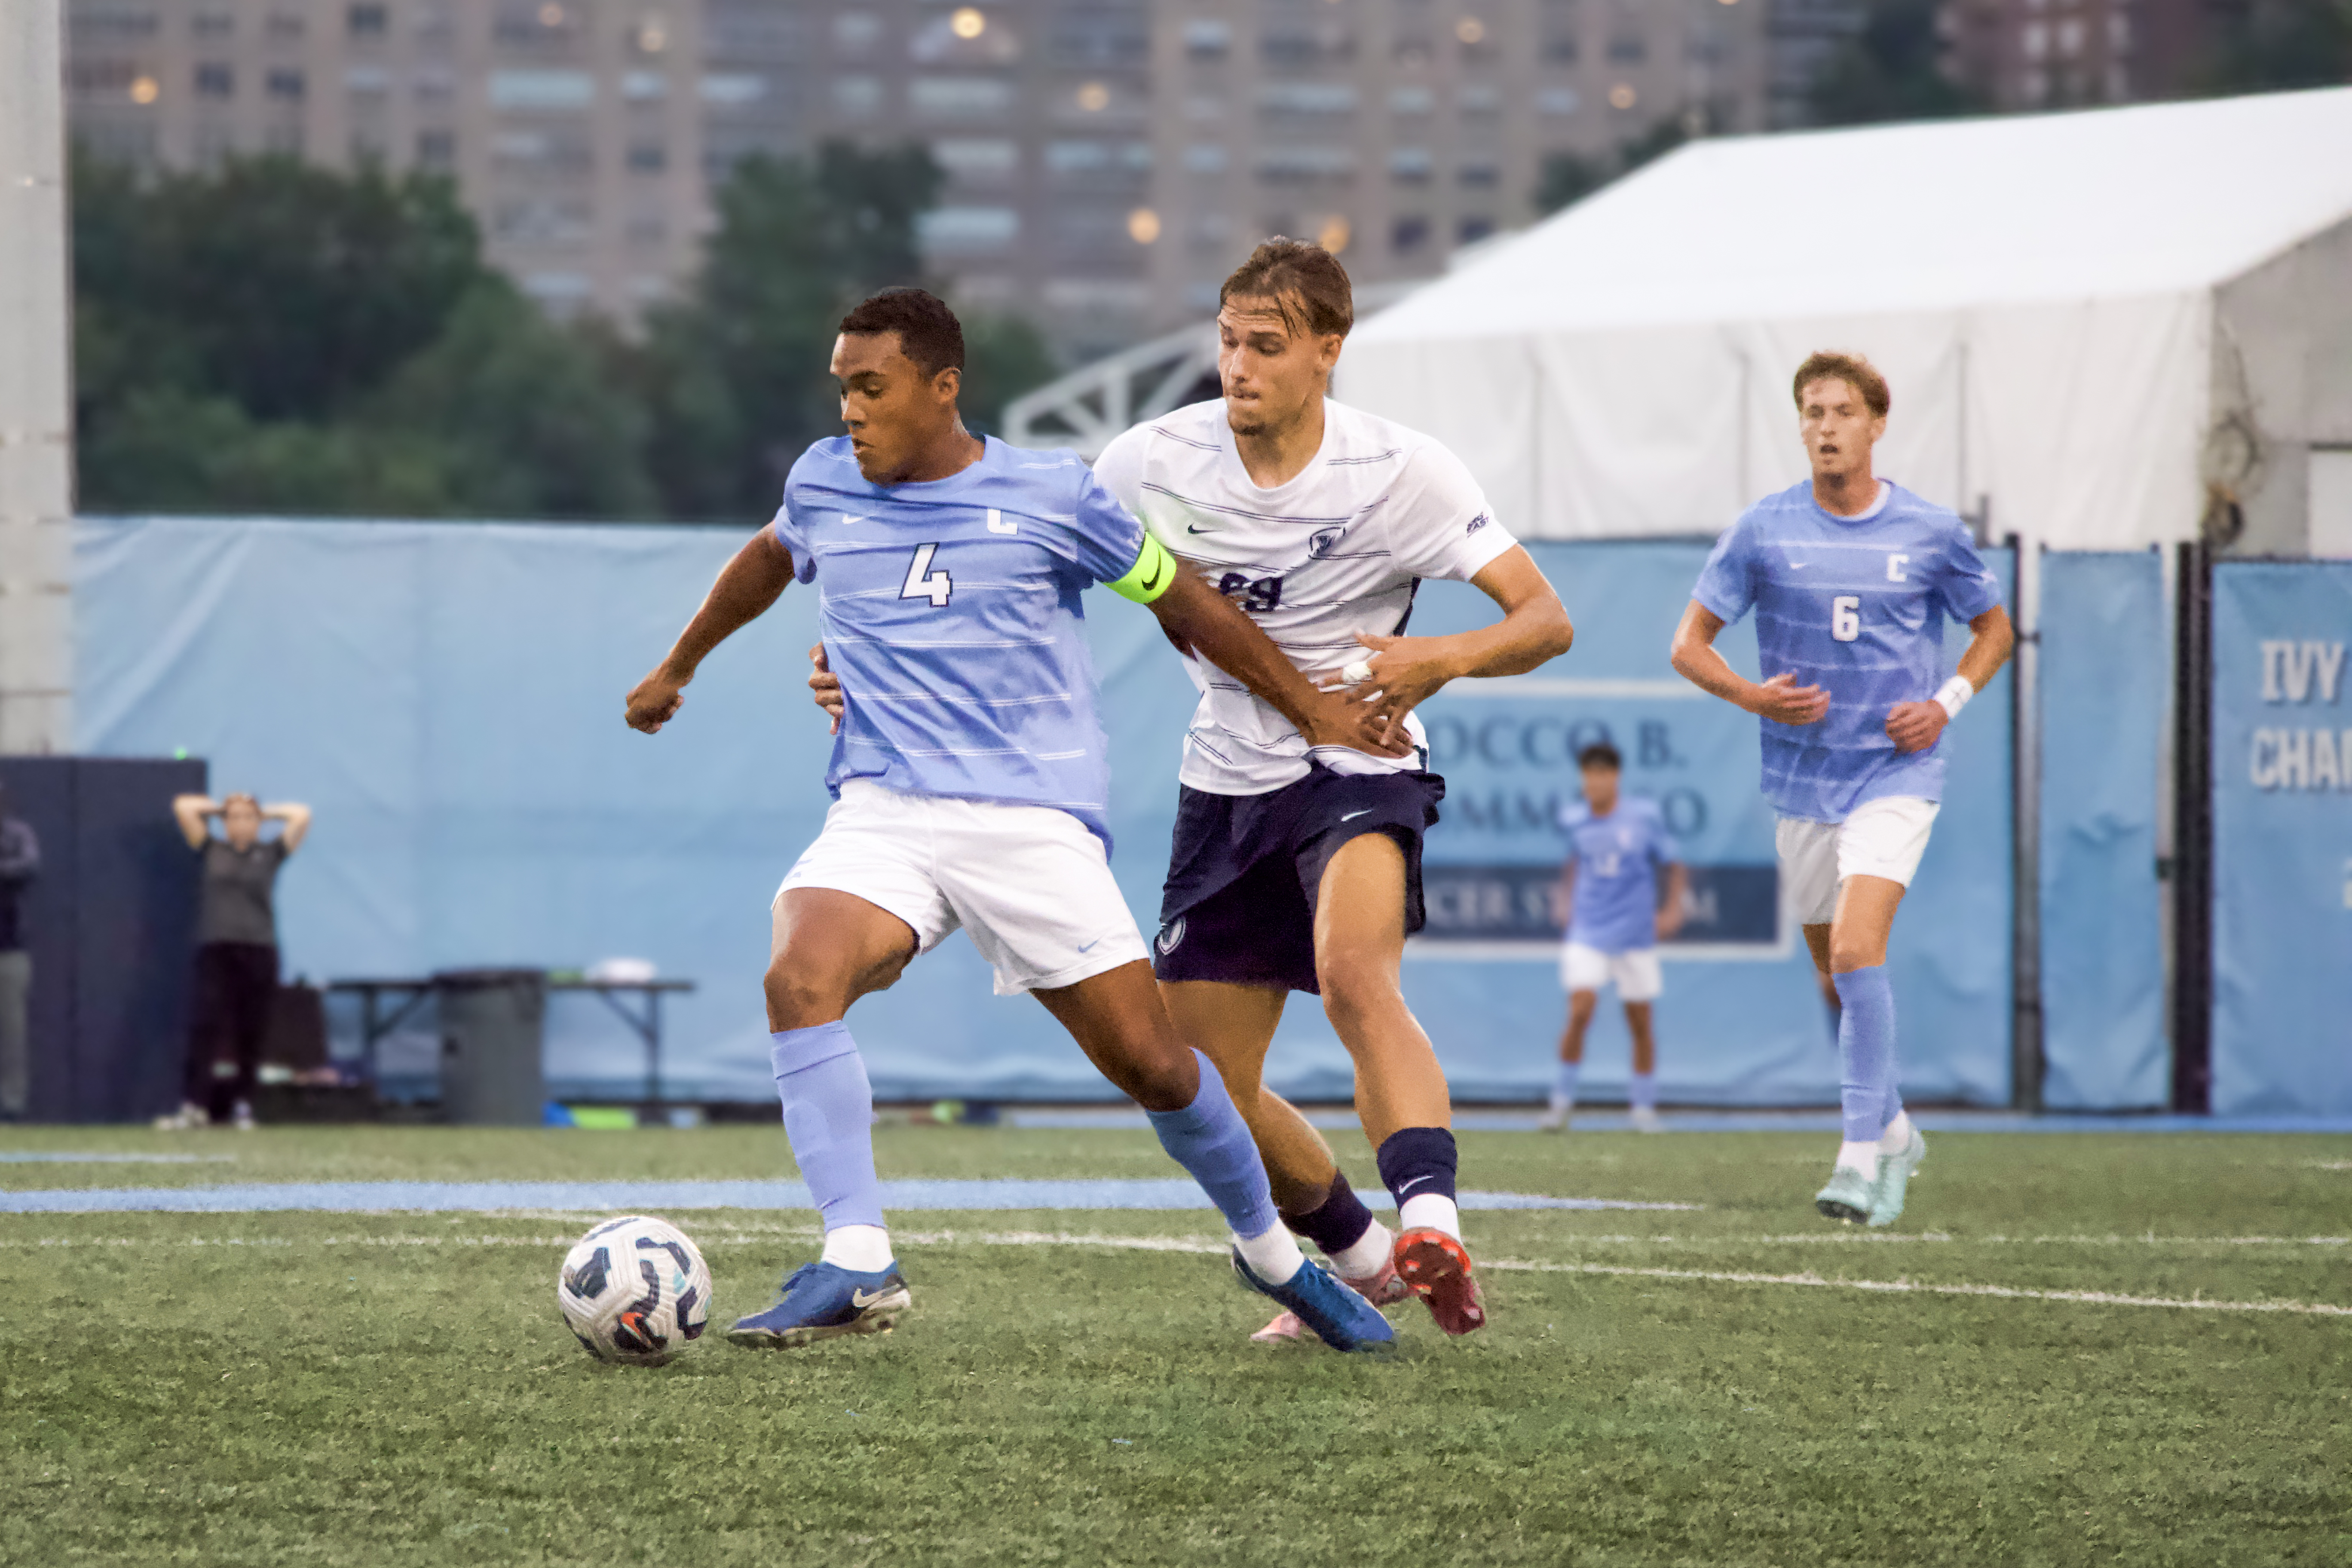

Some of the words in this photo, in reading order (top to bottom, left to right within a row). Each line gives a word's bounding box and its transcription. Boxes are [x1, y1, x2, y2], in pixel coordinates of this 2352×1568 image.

[898, 542, 953, 608] 4
[1886, 554, 1909, 582] C
[1832, 595, 1859, 642] 6
[2261, 640, 2344, 701] IVY
[1428, 715, 1618, 771] OCCO
